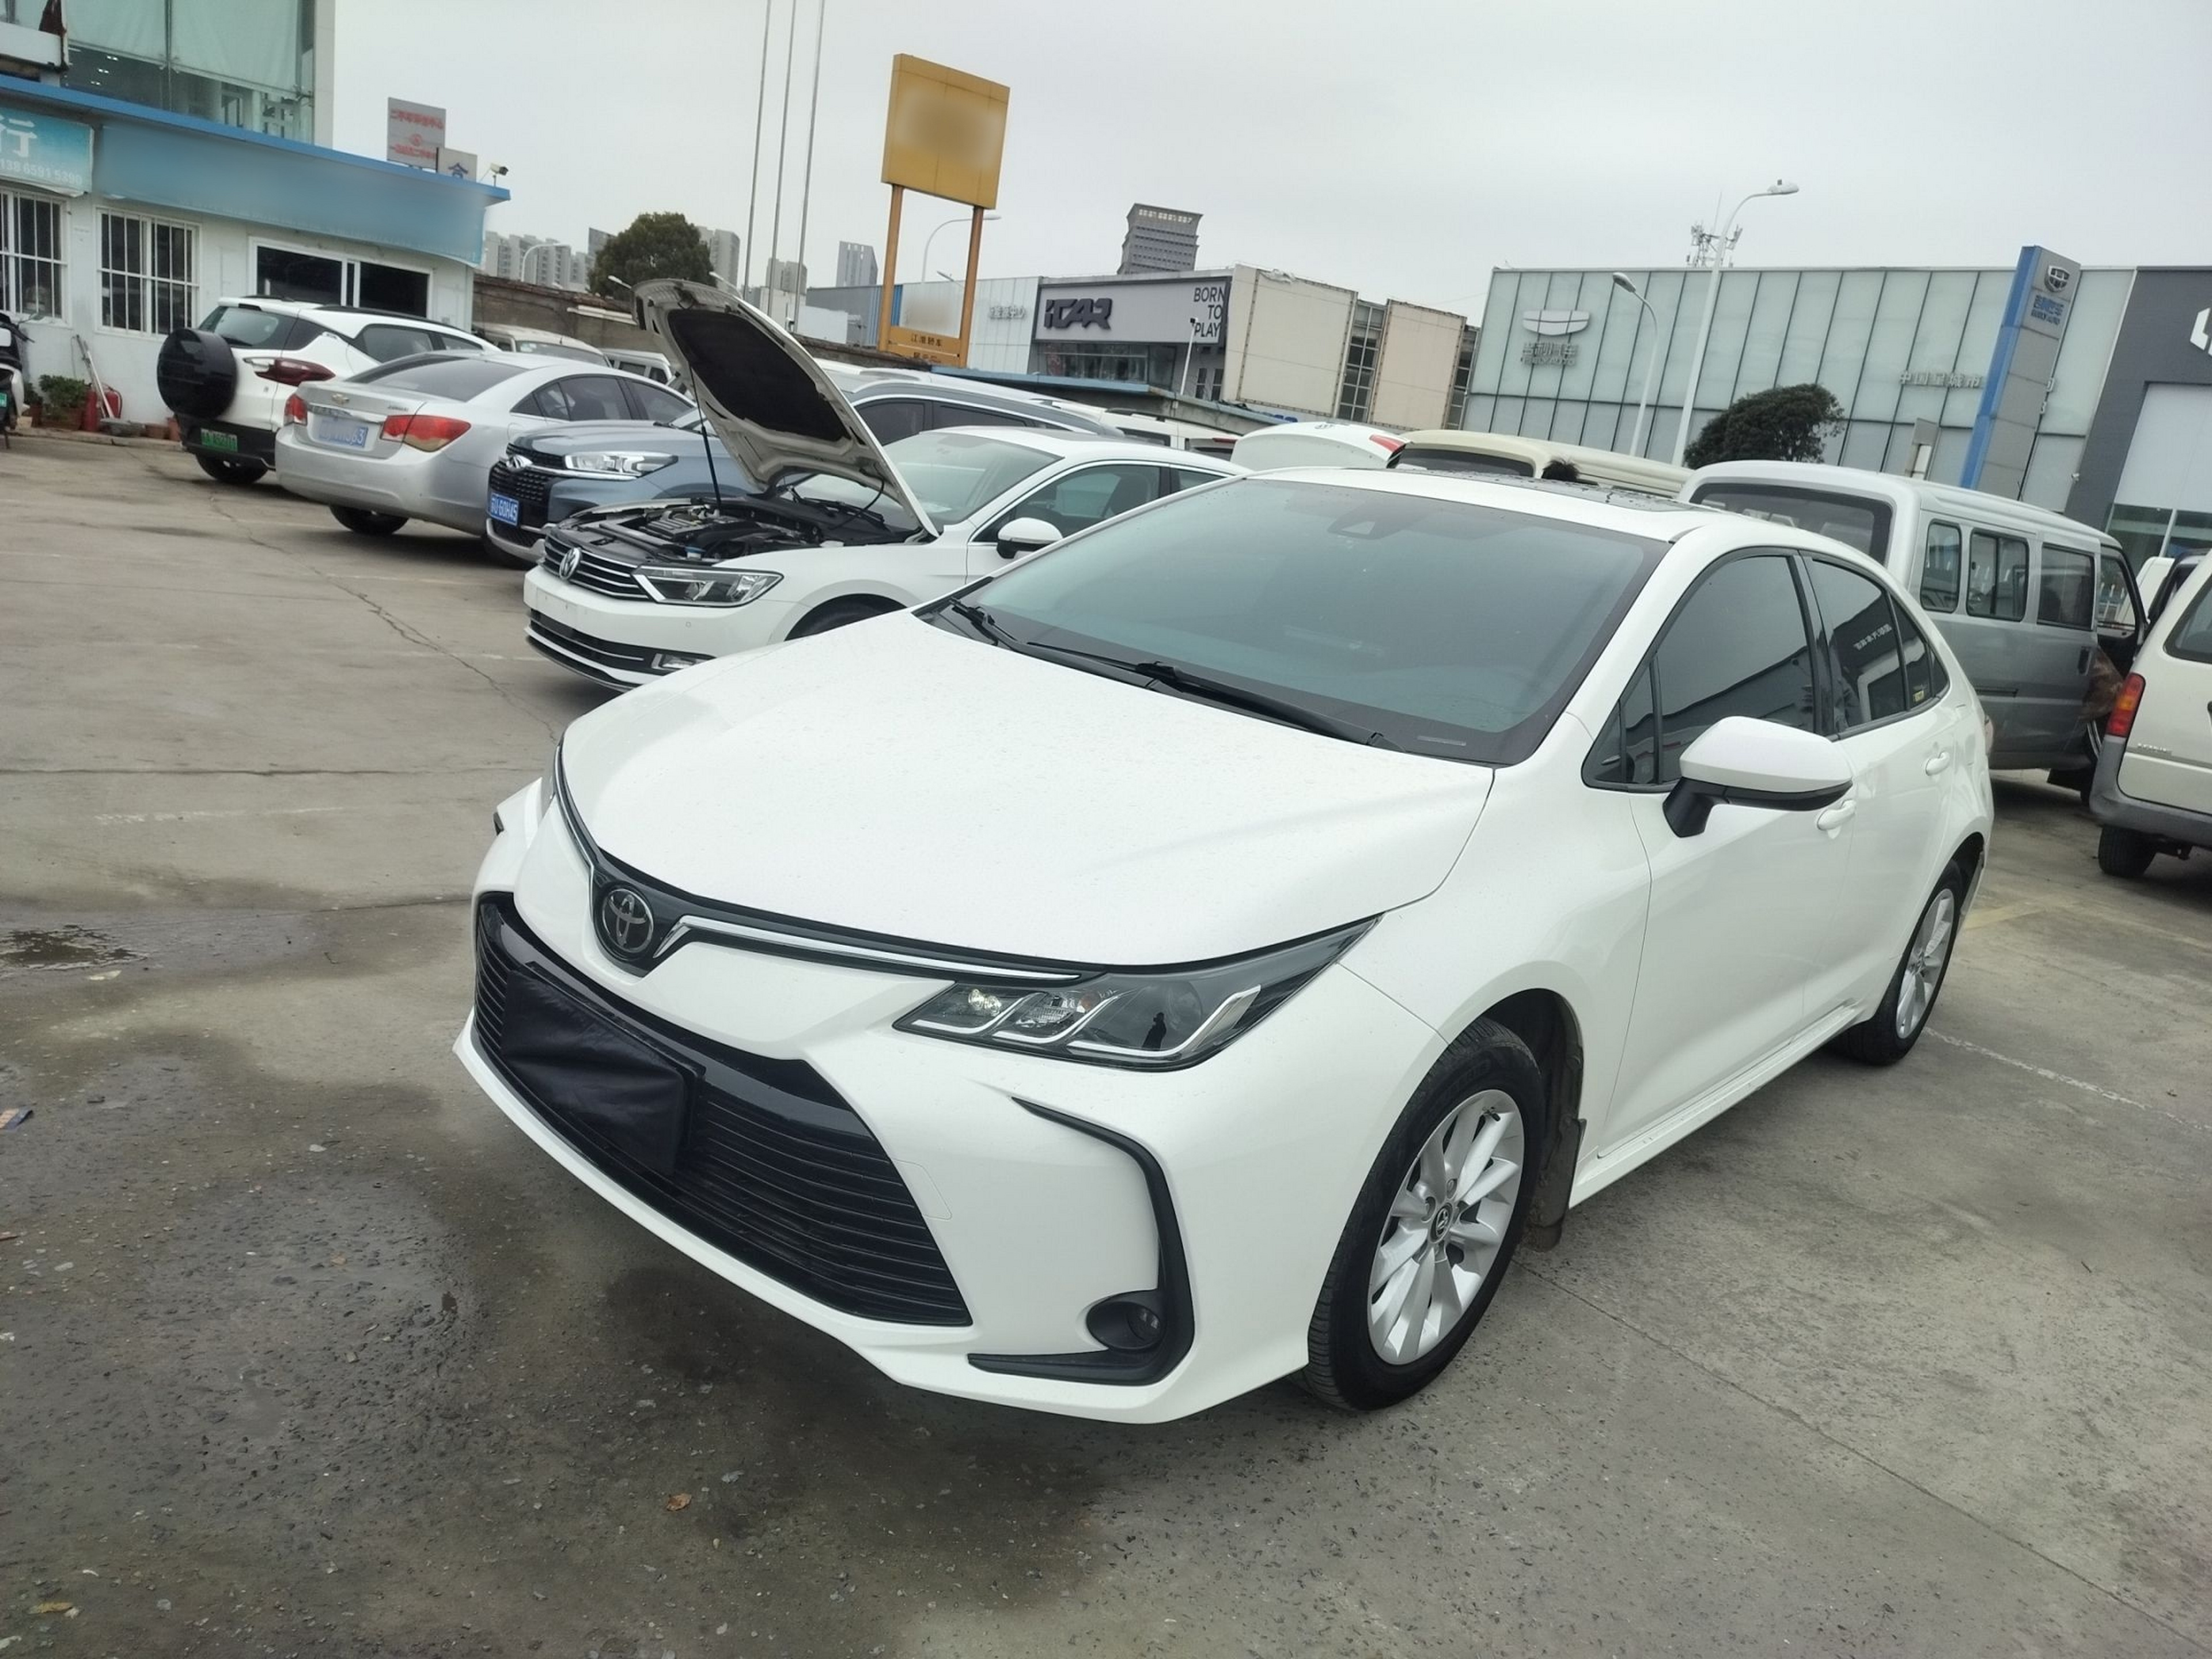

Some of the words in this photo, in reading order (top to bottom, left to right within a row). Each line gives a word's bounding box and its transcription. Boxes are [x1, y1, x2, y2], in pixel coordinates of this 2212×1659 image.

[1194, 287, 1225, 302] BORN
[1208, 305, 1222, 320] TO
[1194, 322, 1221, 337] PLAY
